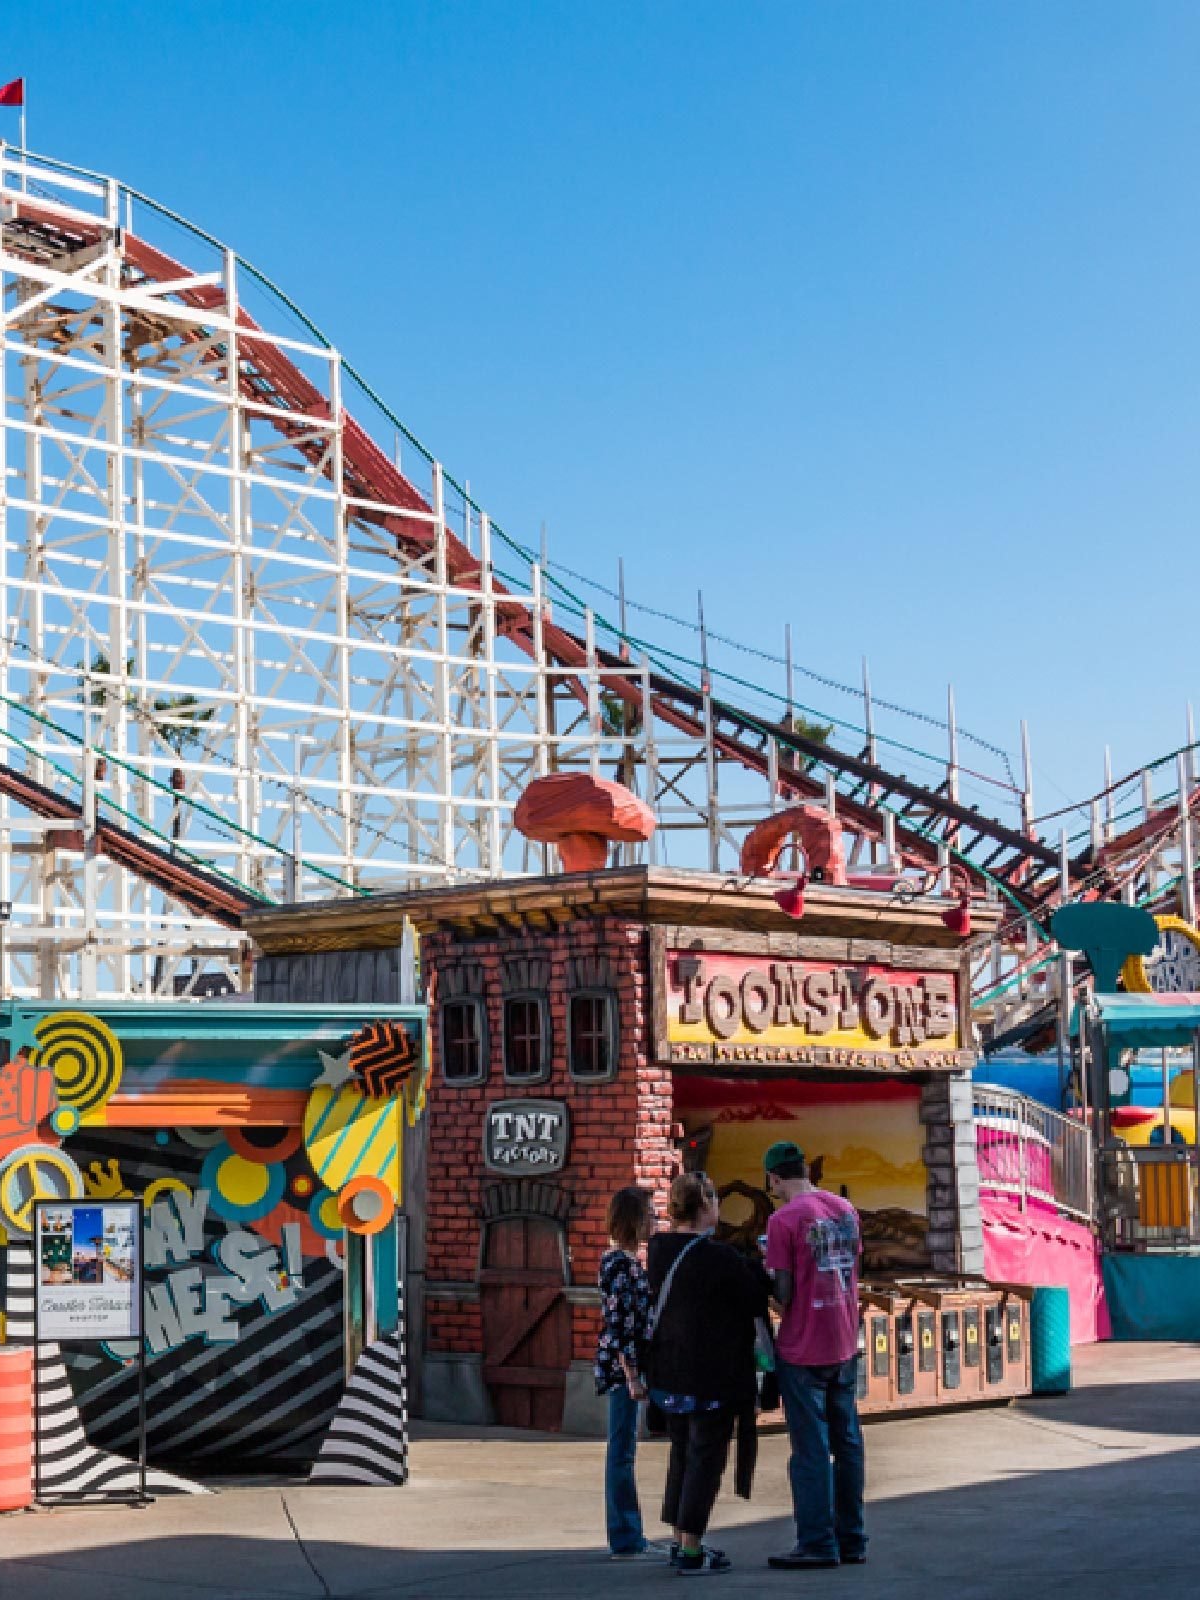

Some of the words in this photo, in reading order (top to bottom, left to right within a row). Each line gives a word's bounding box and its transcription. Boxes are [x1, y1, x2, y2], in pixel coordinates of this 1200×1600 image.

[670, 959, 953, 1048] TOONSTONE
[491, 1113, 559, 1142] TNT
[493, 1144, 558, 1164] FACTORY
[144, 1190, 211, 1265] AY
[103, 1222, 302, 1360] HEESE!
